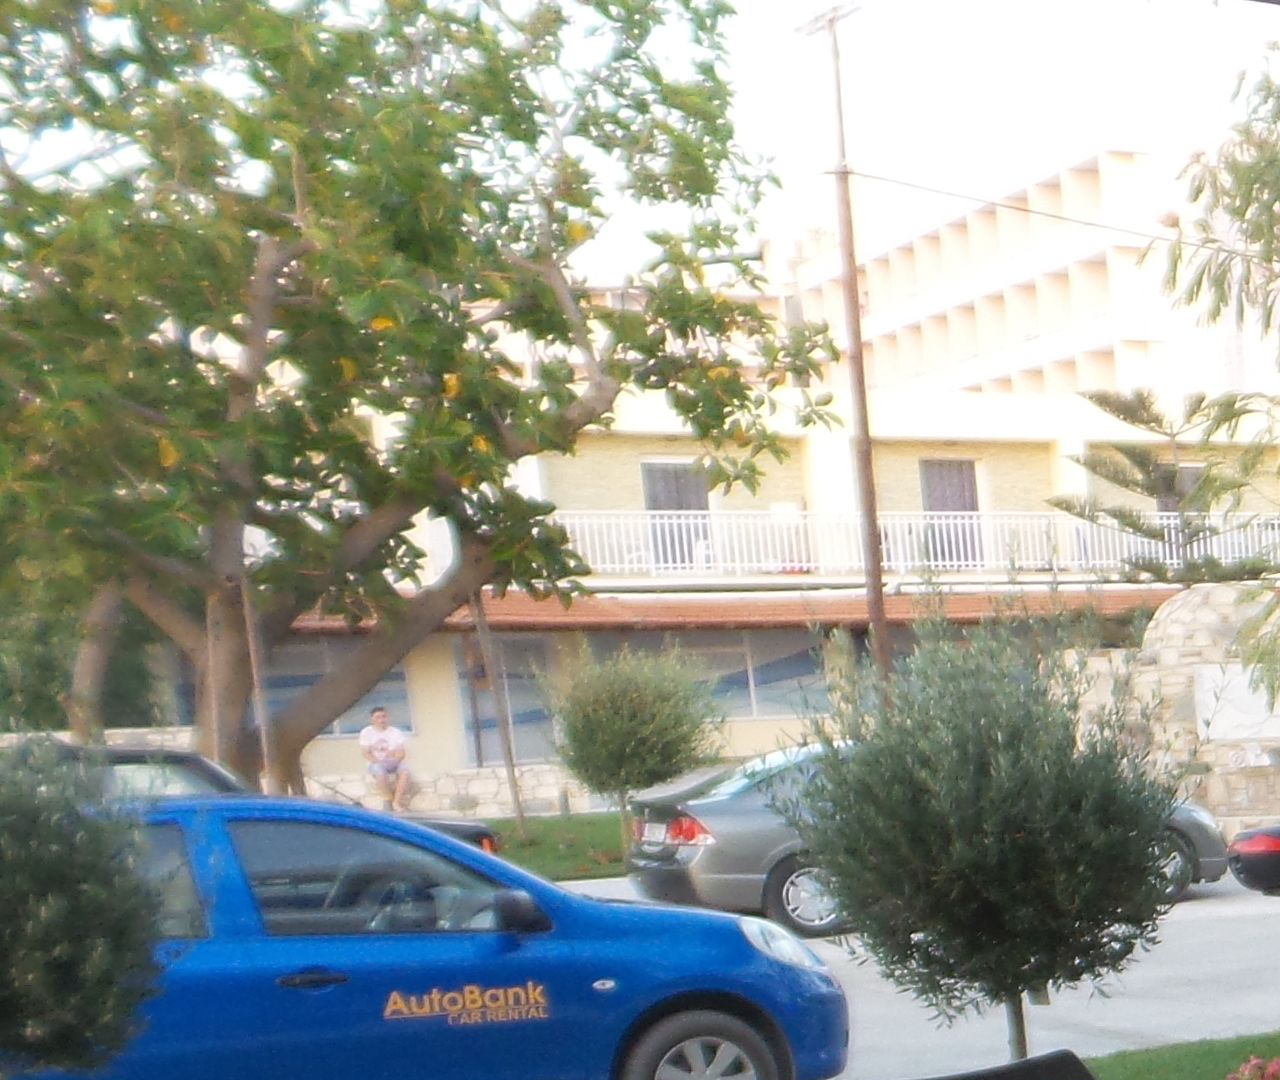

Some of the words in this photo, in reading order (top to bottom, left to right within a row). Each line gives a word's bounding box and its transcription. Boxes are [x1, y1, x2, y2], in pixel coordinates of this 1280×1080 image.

[384, 981, 545, 1015] AutoBank
[448, 1012, 482, 1025] CAR
[488, 1006, 549, 1022] RENTAL
